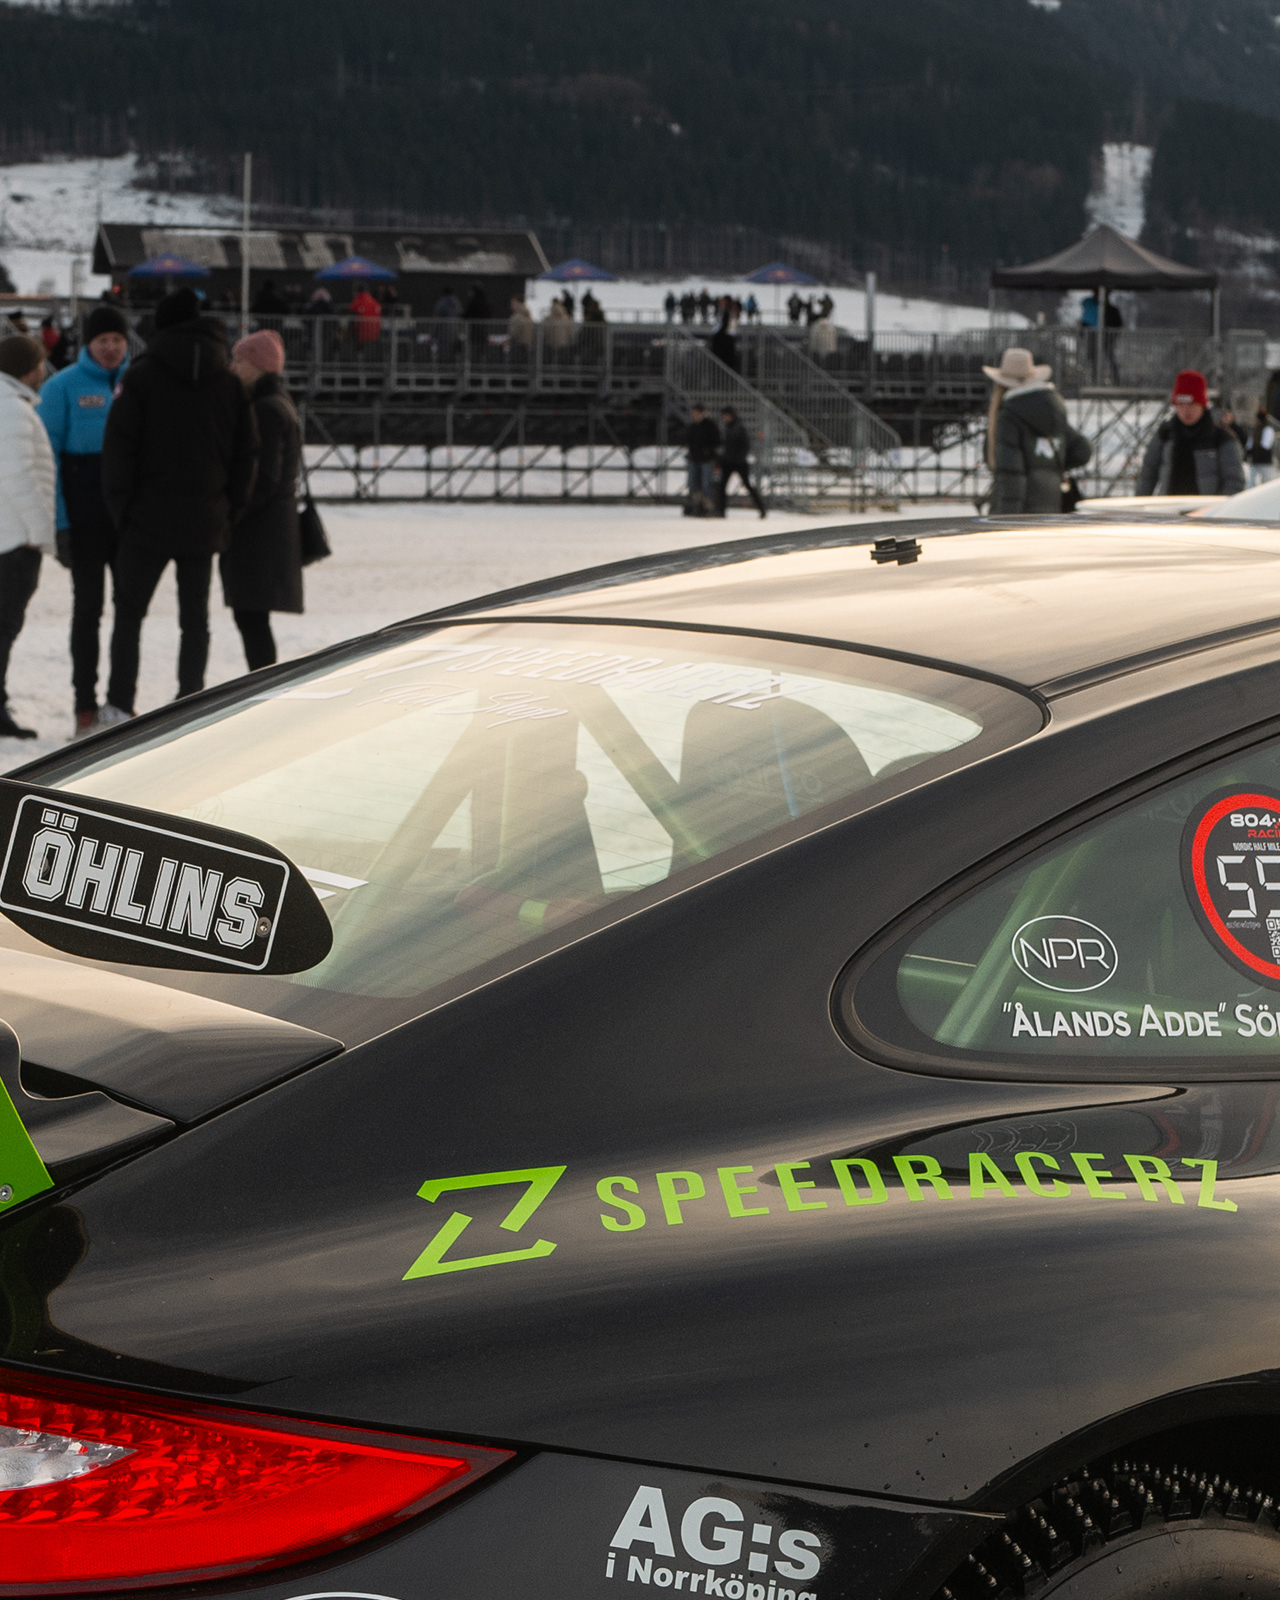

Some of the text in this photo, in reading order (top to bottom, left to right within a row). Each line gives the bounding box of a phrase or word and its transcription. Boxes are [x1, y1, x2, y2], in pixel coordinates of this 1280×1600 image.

[1230, 813, 1273, 828] 804
[1233, 842, 1253, 851] NORDIC
[1253, 842, 1266, 851] HALF
[1267, 842, 1280, 851] MILE
[22, 808, 265, 950] ÖHLINS
[1019, 937, 1111, 970] NPR
[1002, 1002, 1131, 1037] "ÅLANDS
[1139, 1002, 1227, 1037] ADDE"
[596, 1152, 1238, 1232] SPEEDRACERZ
[609, 1484, 822, 1581] AG:s
[605, 1551, 616, 1579] i
